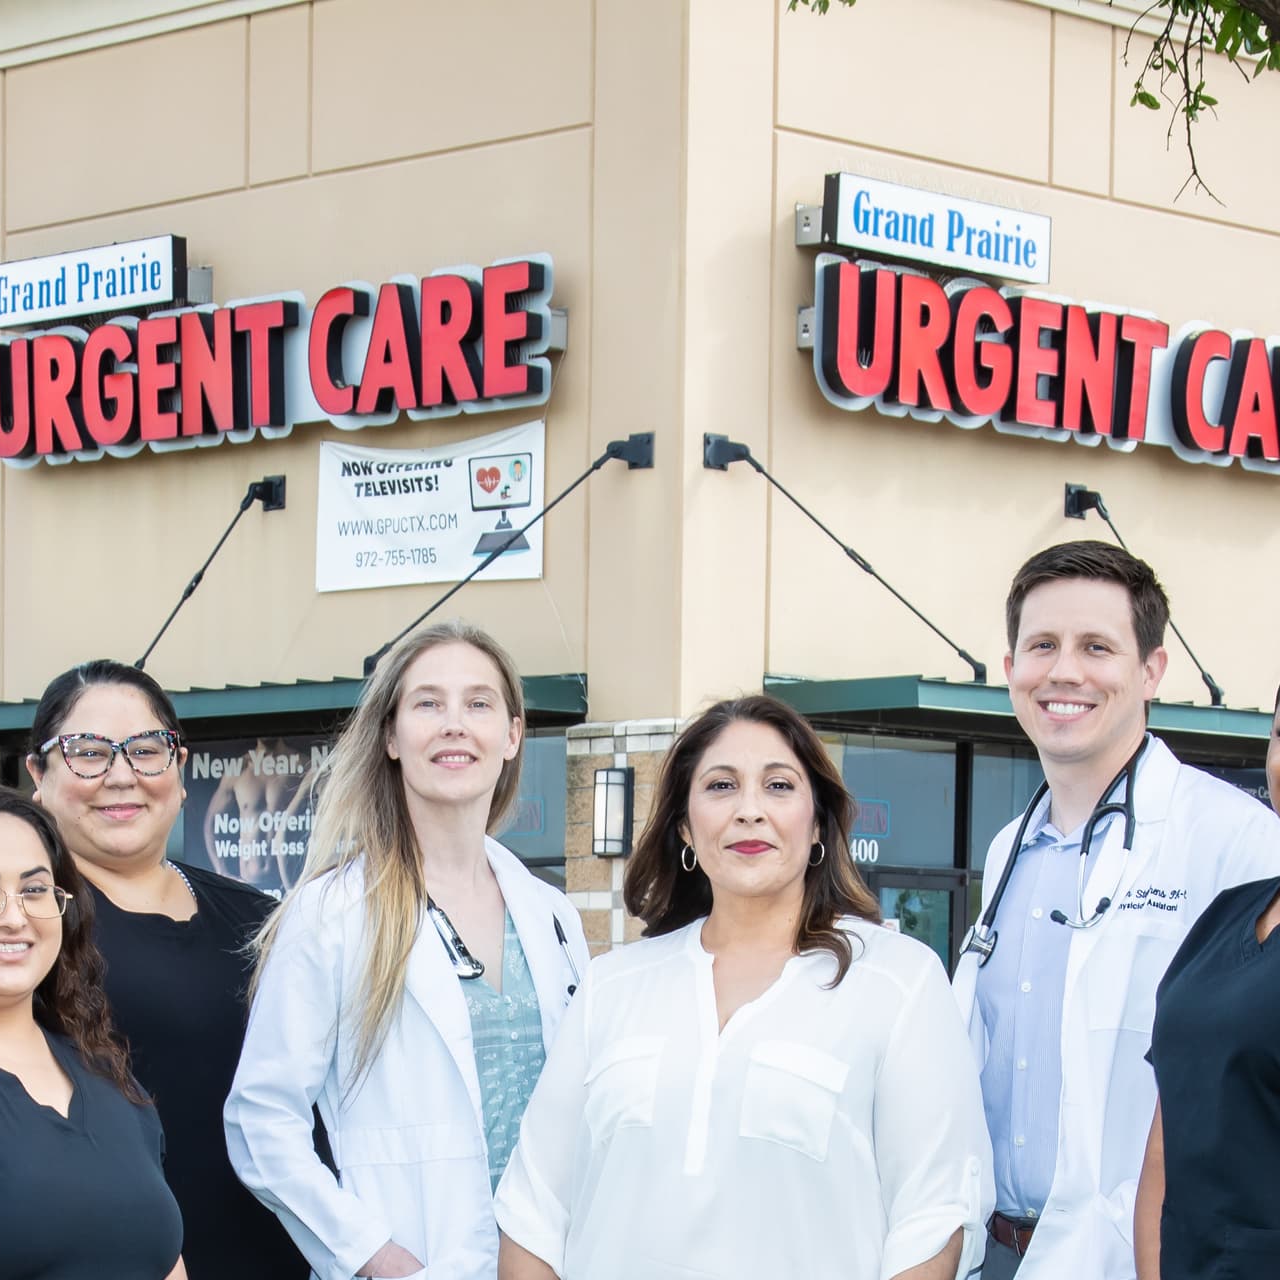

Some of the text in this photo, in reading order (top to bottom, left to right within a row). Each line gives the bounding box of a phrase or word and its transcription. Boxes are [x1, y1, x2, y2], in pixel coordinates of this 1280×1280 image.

[853, 190, 1037, 268] Grand Prairie
[76, 252, 161, 302] Prairie
[308, 260, 538, 415] CARE
[830, 261, 1170, 442] URGENT
[341, 460, 373, 477] NOW
[354, 474, 439, 498] TELEVISITS!
[337, 512, 458, 537] WWW.GPUCTX.COM
[355, 547, 438, 567] 972-755-1785
[192, 751, 243, 779] New
[247, 749, 304, 776] Year.
[214, 808, 312, 834] Now Offeri
[215, 839, 268, 861] Weight
[271, 838, 305, 856] Loss
[850, 839, 879, 863] 400
